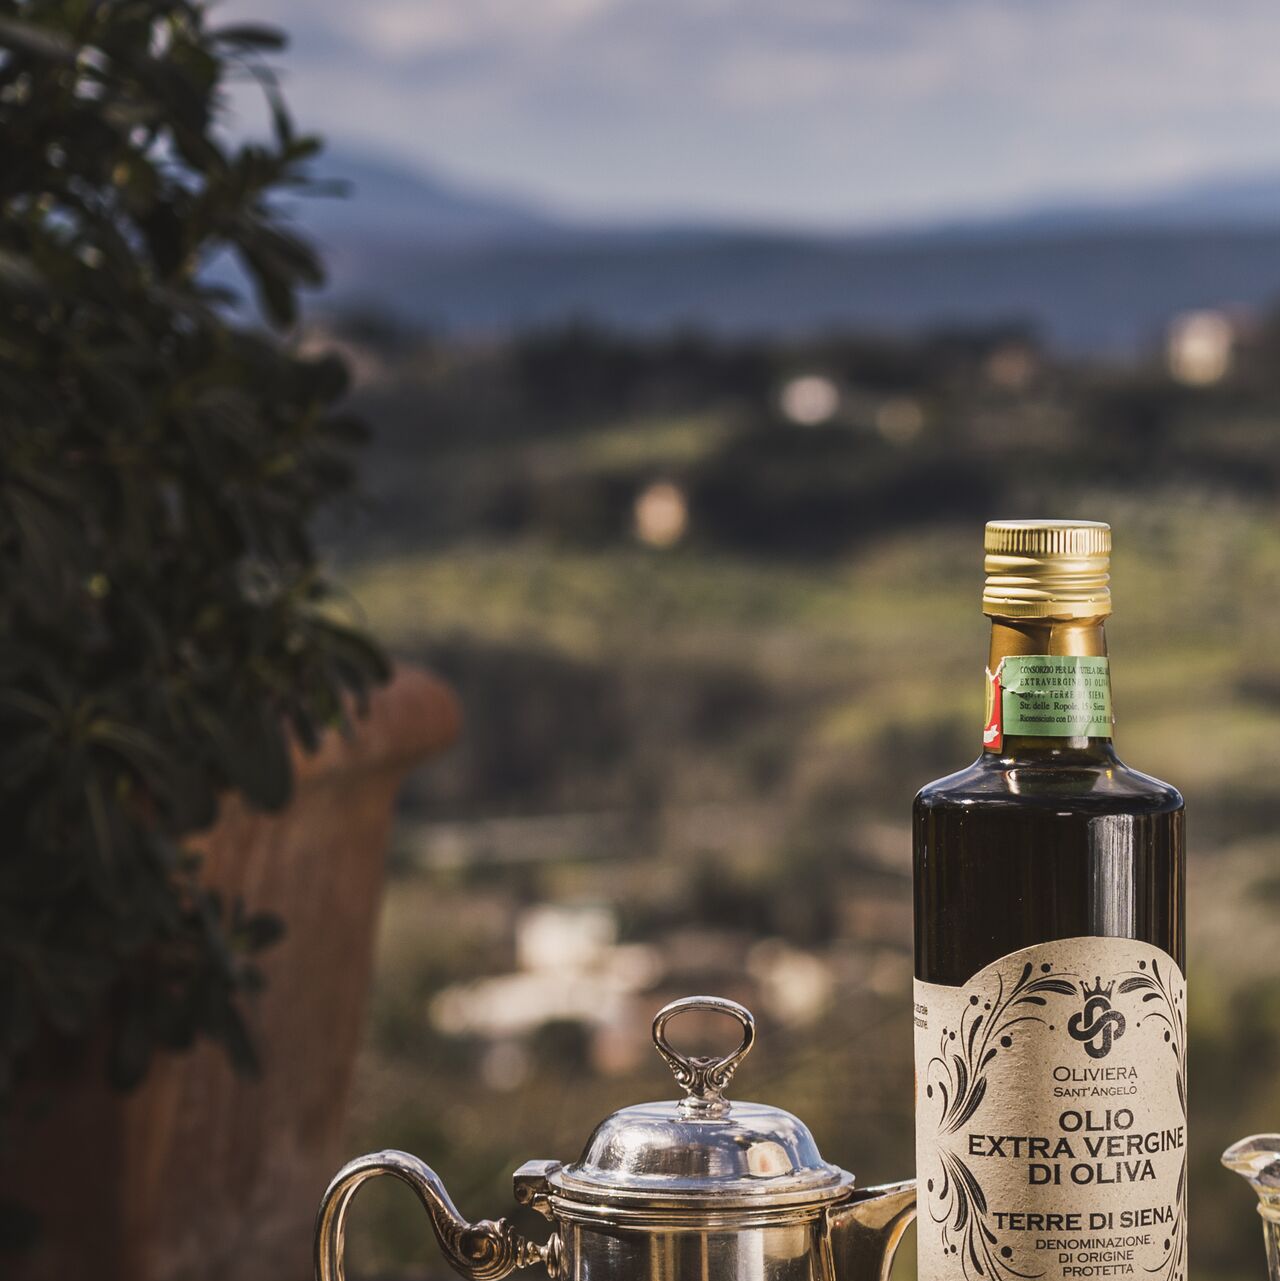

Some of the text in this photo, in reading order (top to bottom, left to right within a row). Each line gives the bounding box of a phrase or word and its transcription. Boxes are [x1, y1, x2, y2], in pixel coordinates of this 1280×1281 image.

[1050, 690, 1074, 699] TERRE
[1033, 702, 1050, 710] delle
[1053, 1066, 1138, 1082] OLIVIERA
[1053, 1086, 1138, 1098] SANT'ANGELO
[1059, 1108, 1134, 1132] OLIO
[968, 1126, 1184, 1159] EXTRA VERGINE
[1028, 1159, 1156, 1185] DI OLIVA
[992, 1205, 1174, 1231] TERRE DI SIENA
[1036, 1234, 1151, 1250] DENOMINAZIONE
[1059, 1250, 1134, 1264] DI ORIGINE
[1063, 1263, 1134, 1277] PROTETTA
